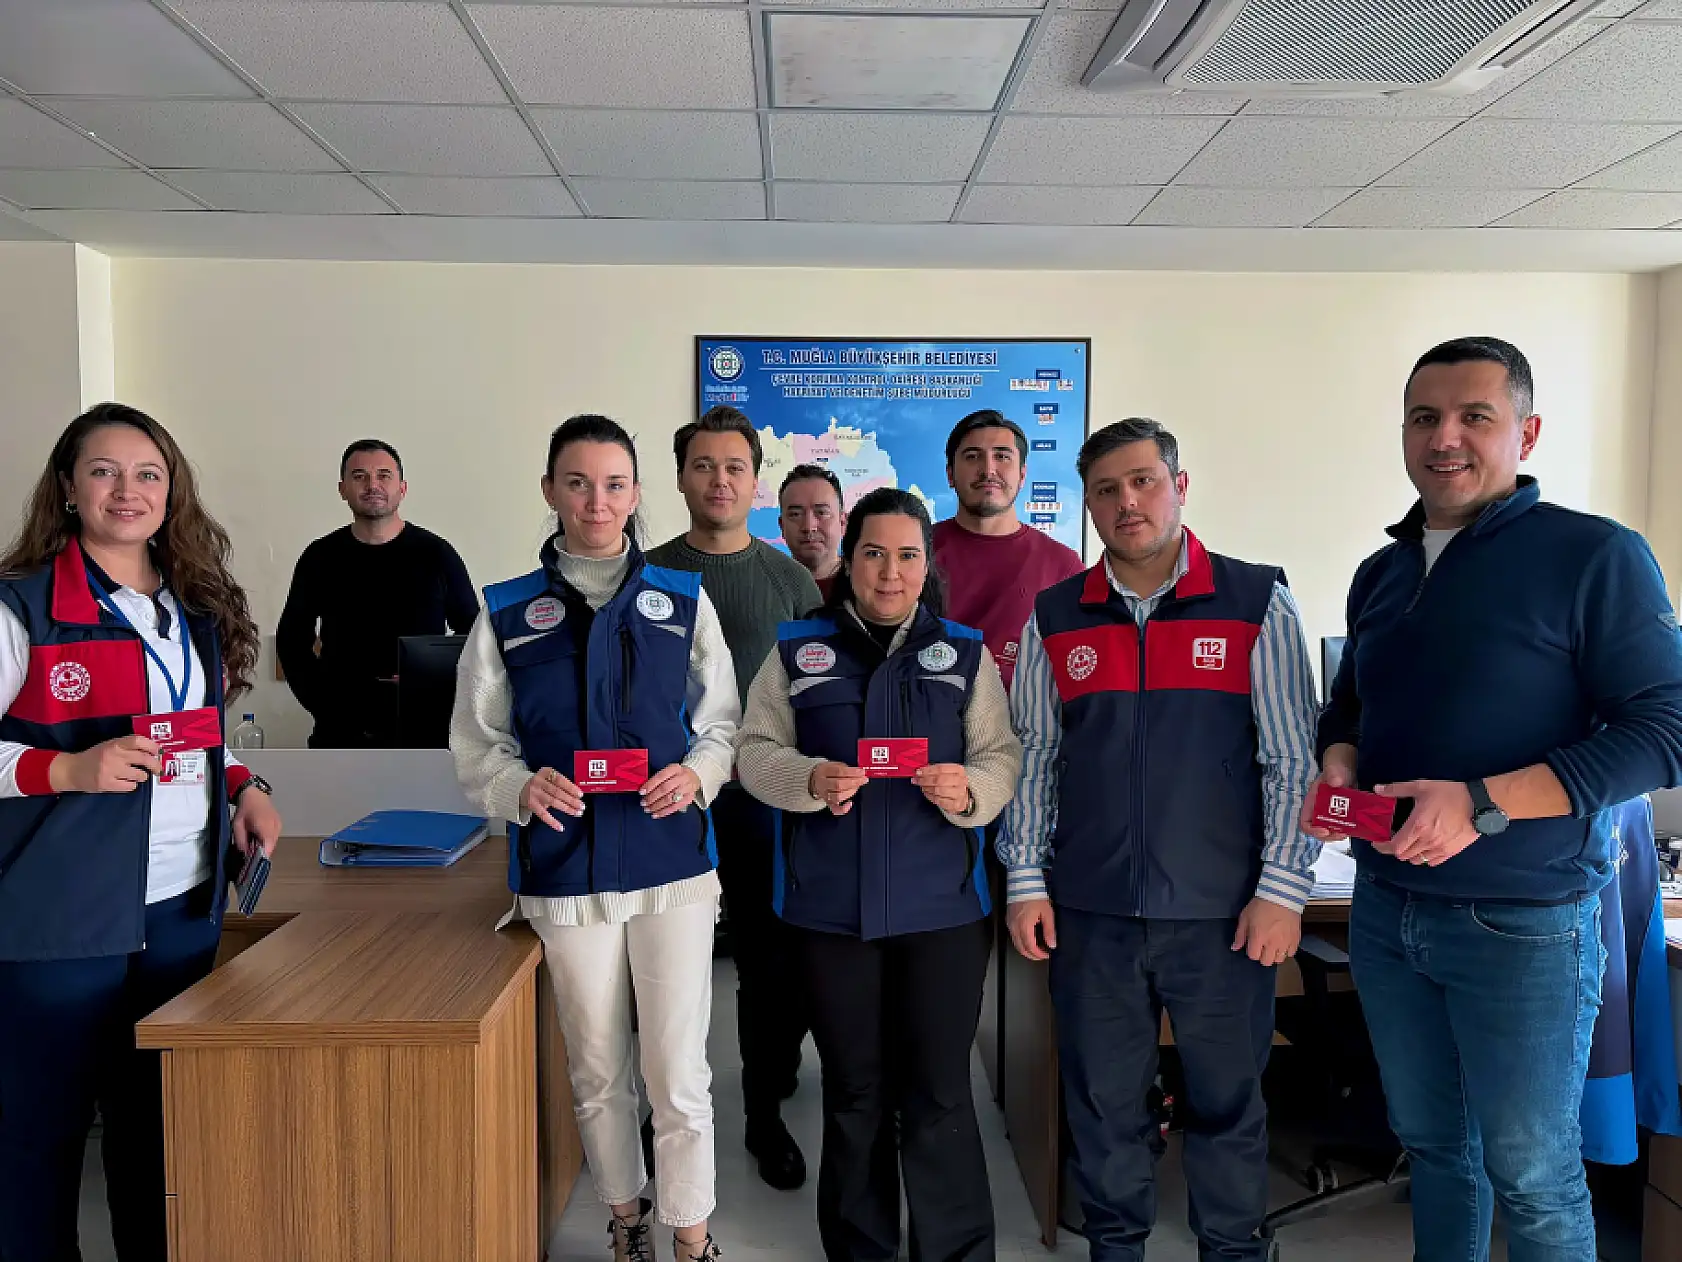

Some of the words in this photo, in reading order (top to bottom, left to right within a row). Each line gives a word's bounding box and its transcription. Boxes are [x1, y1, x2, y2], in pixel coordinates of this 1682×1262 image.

[762, 349, 787, 365] T.C.
[790, 347, 836, 365] MUĞLA
[839, 347, 921, 368] BÜYÜKŞEHİR
[925, 347, 998, 366] BELEDİYESİ
[771, 373, 803, 386] ÇEVRE
[1198, 641, 1222, 656] 112
